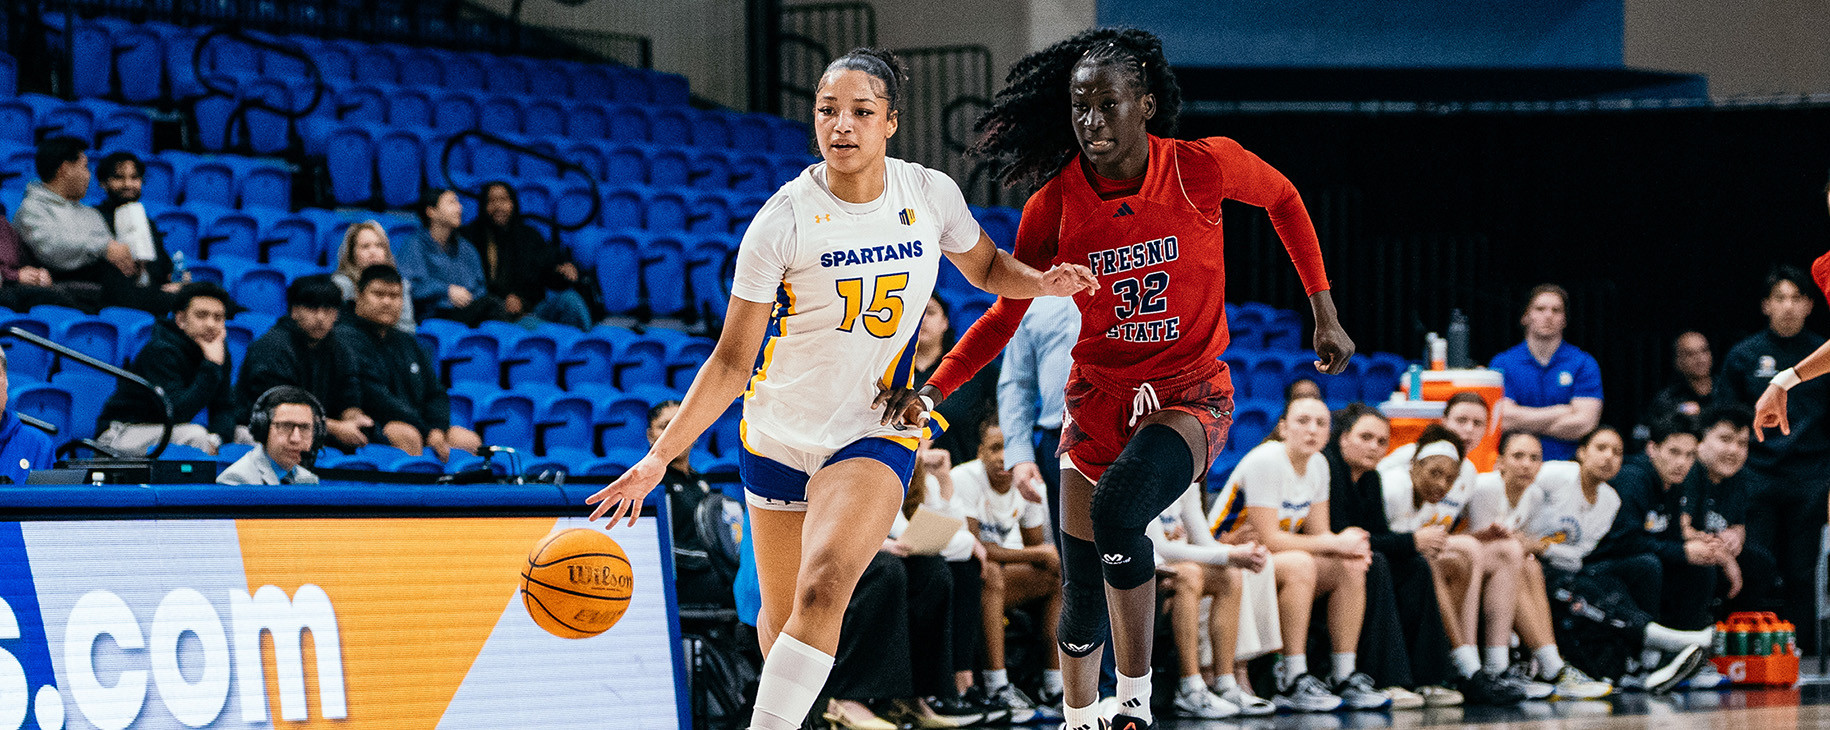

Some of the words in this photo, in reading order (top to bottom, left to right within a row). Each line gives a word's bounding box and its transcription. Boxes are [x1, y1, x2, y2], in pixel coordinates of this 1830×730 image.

[820, 240, 923, 268] SPARTANS
[1088, 235, 1179, 276] FRESNO
[835, 271, 909, 339] 15
[1112, 270, 1170, 320] 32
[1106, 316, 1180, 343] STATE
[567, 565, 632, 588] Wilson
